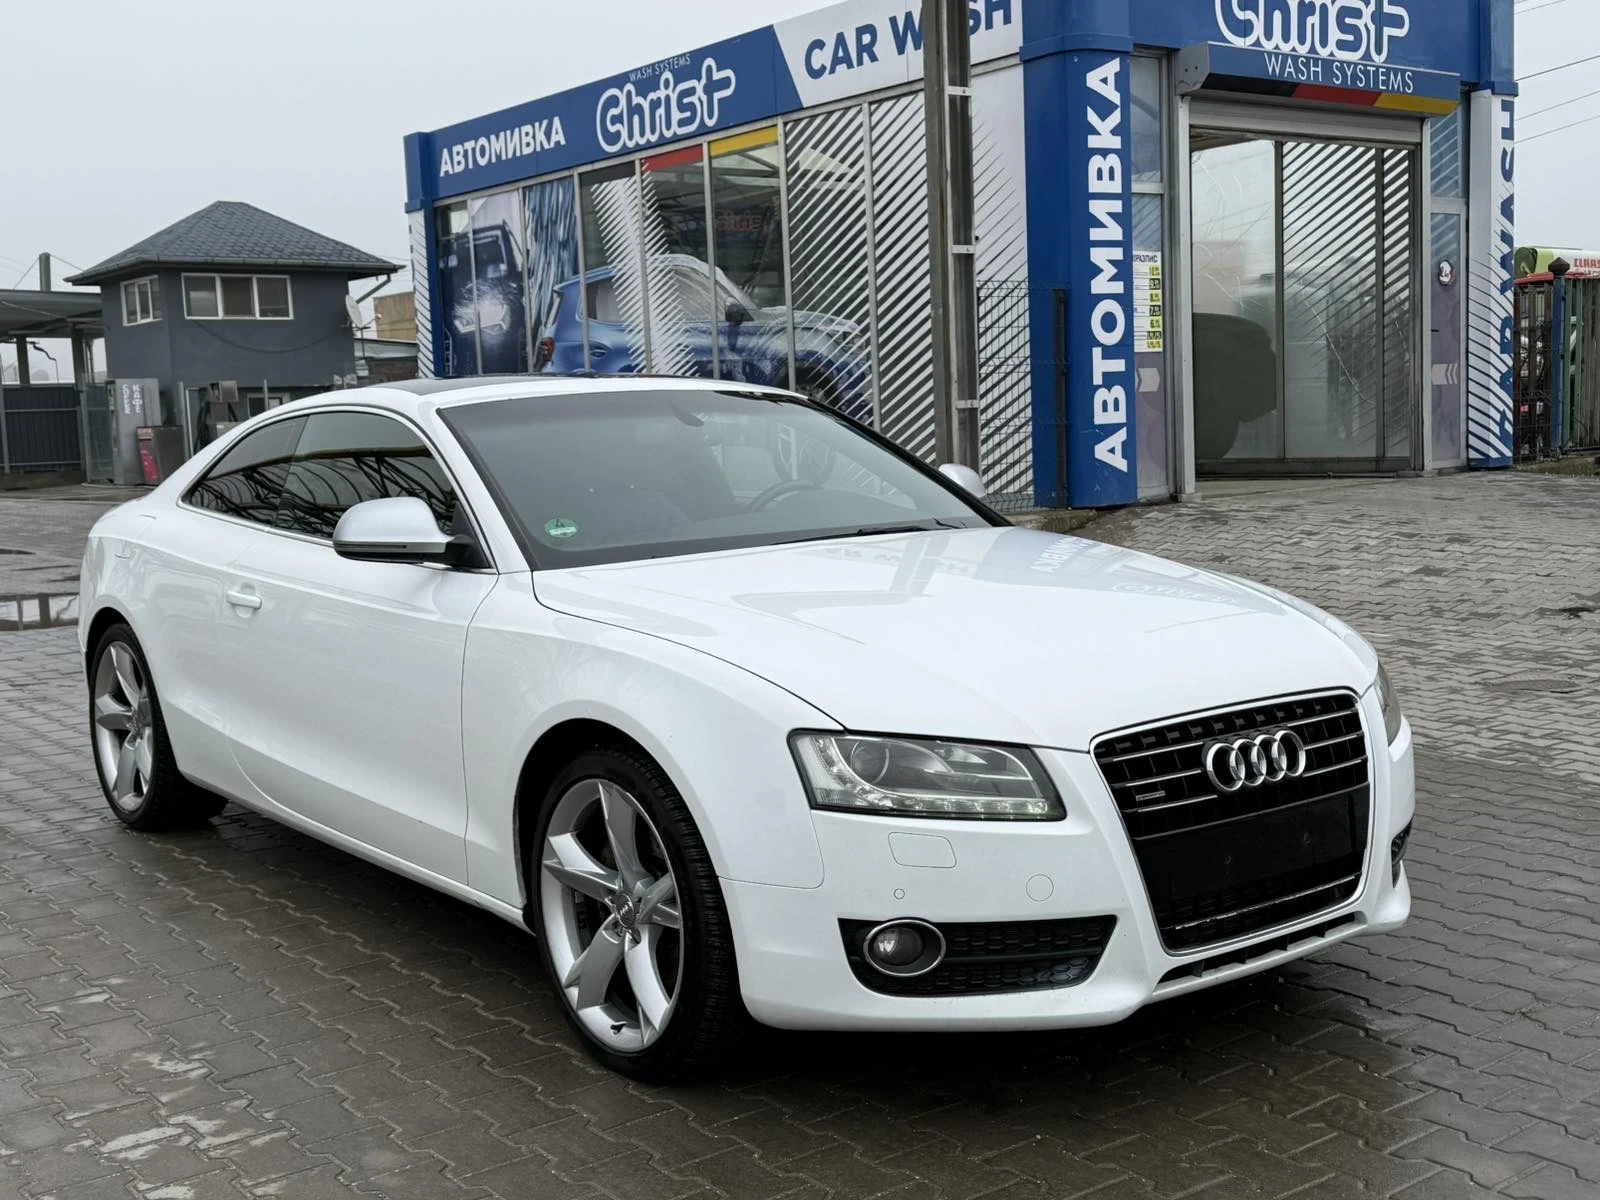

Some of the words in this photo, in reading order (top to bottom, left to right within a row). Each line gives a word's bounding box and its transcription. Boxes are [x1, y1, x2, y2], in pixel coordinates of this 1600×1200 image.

[628, 65, 653, 83] WASH
[655, 53, 691, 75] SYSTEMS
[804, 23, 879, 80] CAR
[1264, 52, 1323, 82] WASH
[1332, 61, 1414, 94] SYSTEMS
[596, 57, 736, 153] Christ
[439, 115, 567, 178] АВТОМИВКА
[1085, 56, 1128, 473] АВТОМИВКА
